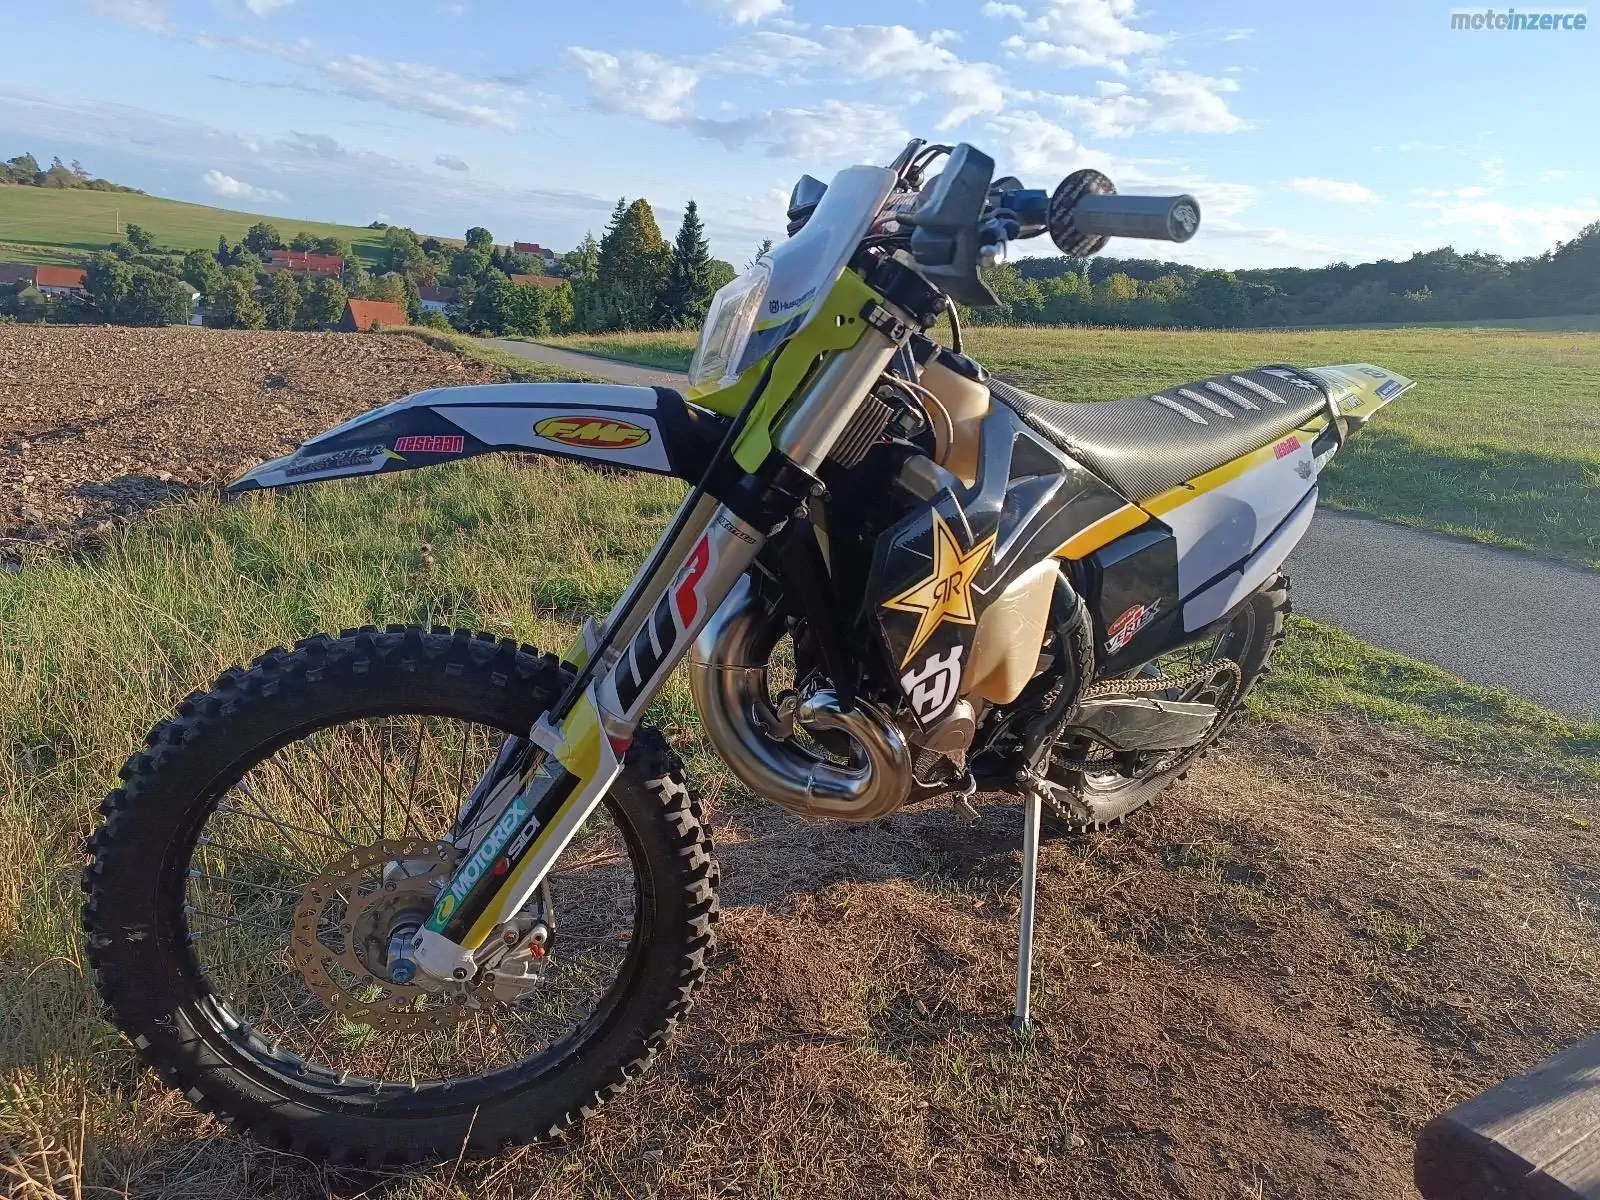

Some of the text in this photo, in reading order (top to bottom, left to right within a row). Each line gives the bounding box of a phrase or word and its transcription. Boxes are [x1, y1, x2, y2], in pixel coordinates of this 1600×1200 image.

[540, 420, 646, 442] FMF
[394, 436, 464, 453] nestaan
[451, 803, 528, 901] MOTOREX
